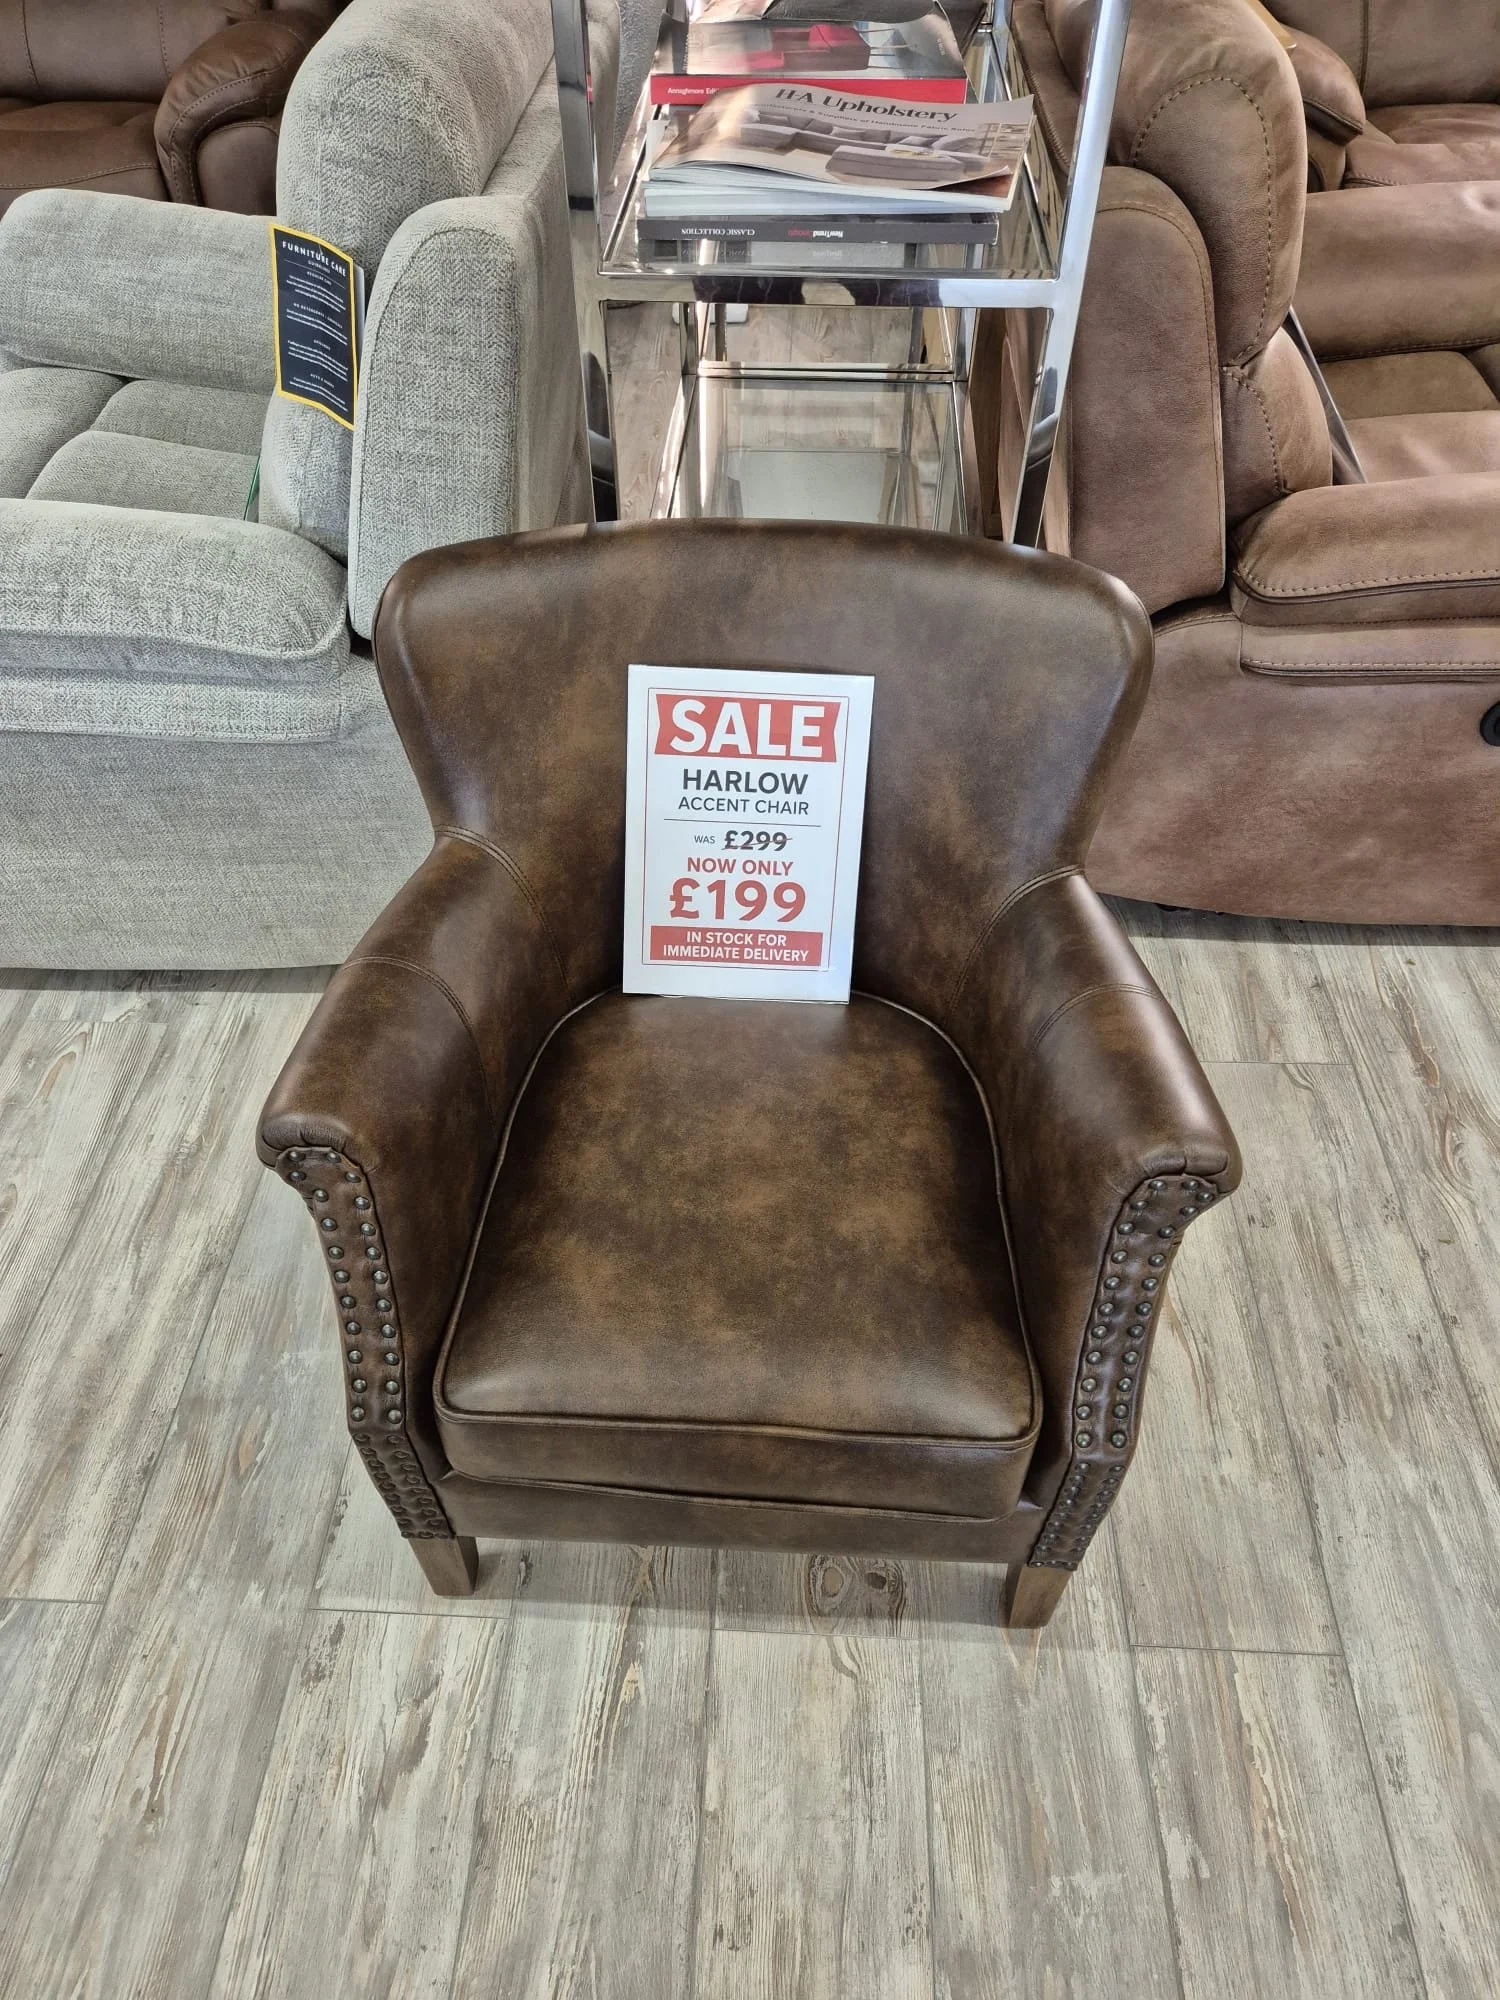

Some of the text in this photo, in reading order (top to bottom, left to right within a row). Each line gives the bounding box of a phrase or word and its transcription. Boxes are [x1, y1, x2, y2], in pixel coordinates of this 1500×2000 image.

[822, 95, 958, 122] Upholstery
[282, 241, 346, 277] FURNITURE CARE
[670, 699, 825, 758] SALE
[682, 768, 809, 795] HARLOW
[678, 796, 809, 816] ACCENT CHAIR
[694, 830, 792, 852] WAS £299
[687, 857, 794, 876] NOW ONLY
[669, 877, 806, 923] £199
[686, 931, 787, 947] IN STOCK FOR
[663, 944, 809, 962] IMMEDIATE DELIVERY
